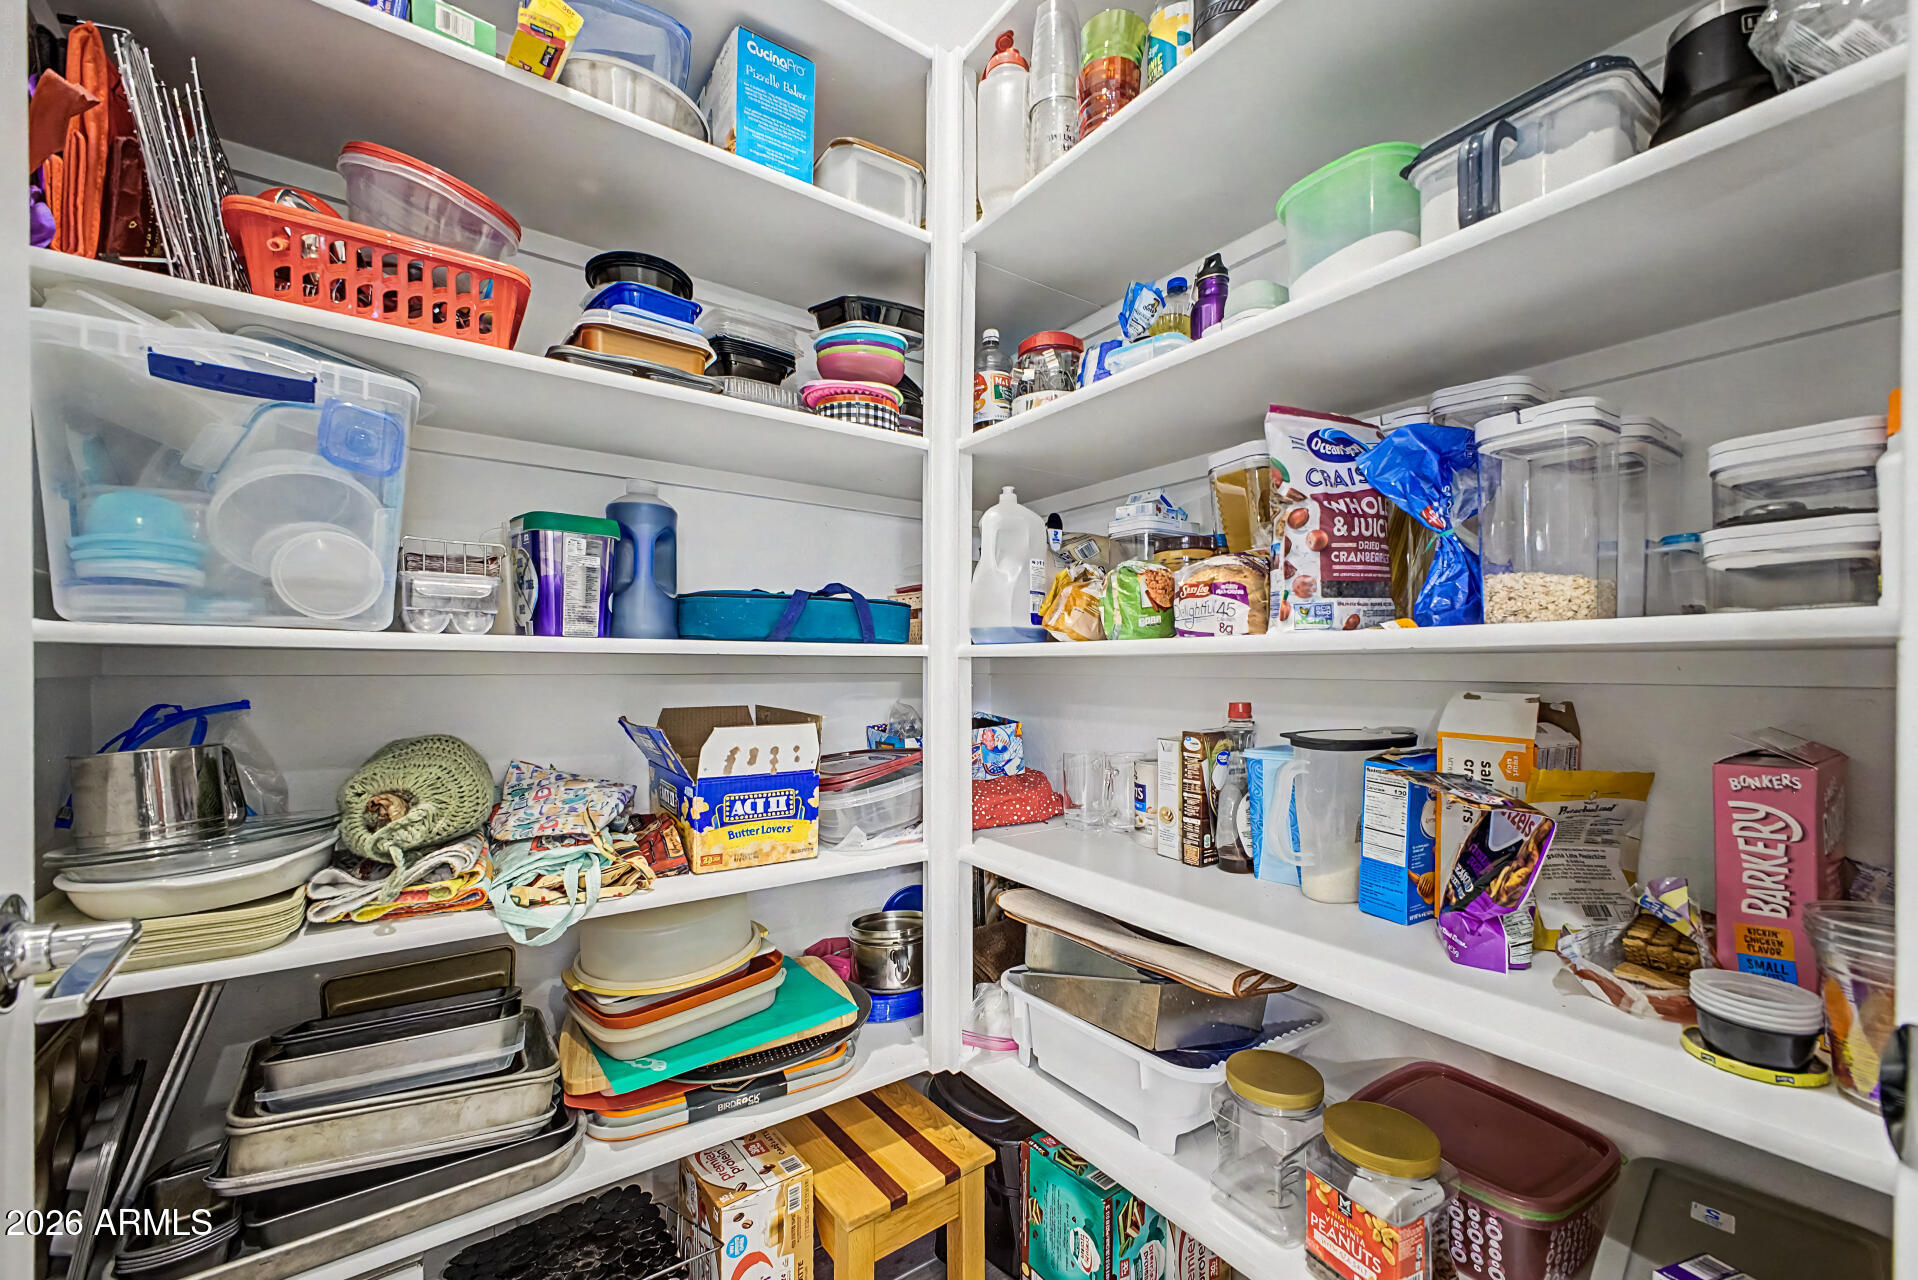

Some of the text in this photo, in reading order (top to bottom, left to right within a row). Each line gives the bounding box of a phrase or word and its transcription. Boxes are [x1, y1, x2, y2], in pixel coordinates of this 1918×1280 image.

[1311, 437, 1343, 455] Ocean
[1305, 467, 1369, 488] CRAIS
[1333, 516, 1349, 536] &
[1216, 602, 1236, 617] 45
[1728, 773, 1802, 791] BONKERS
[731, 796, 788, 816] ACT II
[728, 827, 760, 840] Butter
[1727, 800, 1803, 919] BARKERY
[1744, 934, 1785, 948] CHICKEN
[1747, 944, 1782, 956] FLAVOR
[1746, 959, 1789, 975] SMALL
[704, 1150, 735, 1182] premier
[1324, 1213, 1366, 1248] VIRGINIA
[1310, 1211, 1382, 1274] PEANUTS
